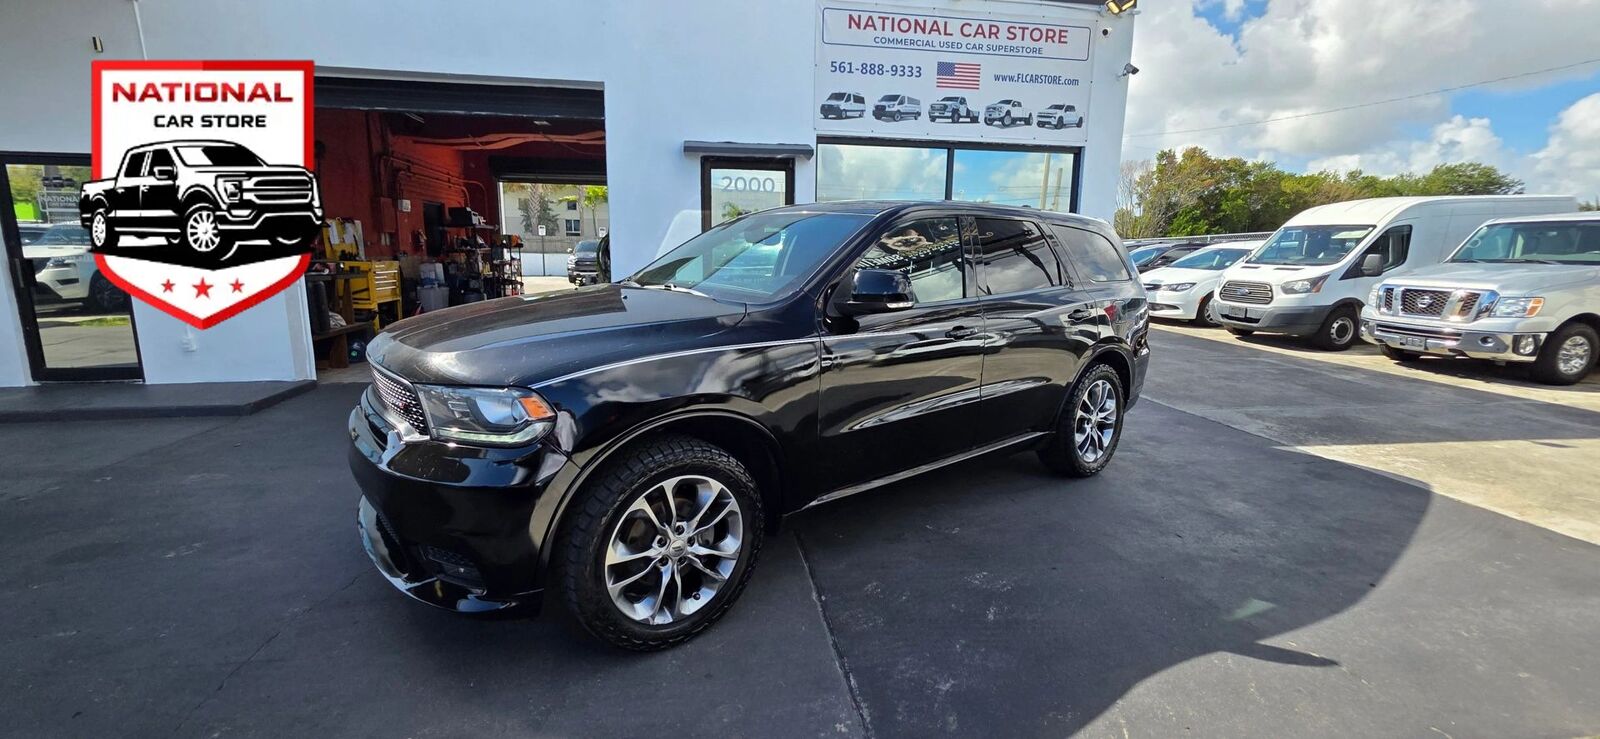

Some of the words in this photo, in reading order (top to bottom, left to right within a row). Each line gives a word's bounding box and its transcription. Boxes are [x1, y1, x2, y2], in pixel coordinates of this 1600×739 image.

[848, 14, 953, 36] NATIONAL
[959, 22, 1000, 40] CAR
[1006, 26, 1069, 44] STORE
[873, 36, 936, 48] COMMERCIAL
[939, 40, 963, 50] USED
[965, 42, 984, 51] CAR
[986, 43, 1044, 55] SUPERSTORE
[830, 61, 922, 78] 561-888-9333
[993, 73, 1080, 86] www.FLCARSTORE.com
[721, 176, 775, 192] 2000
